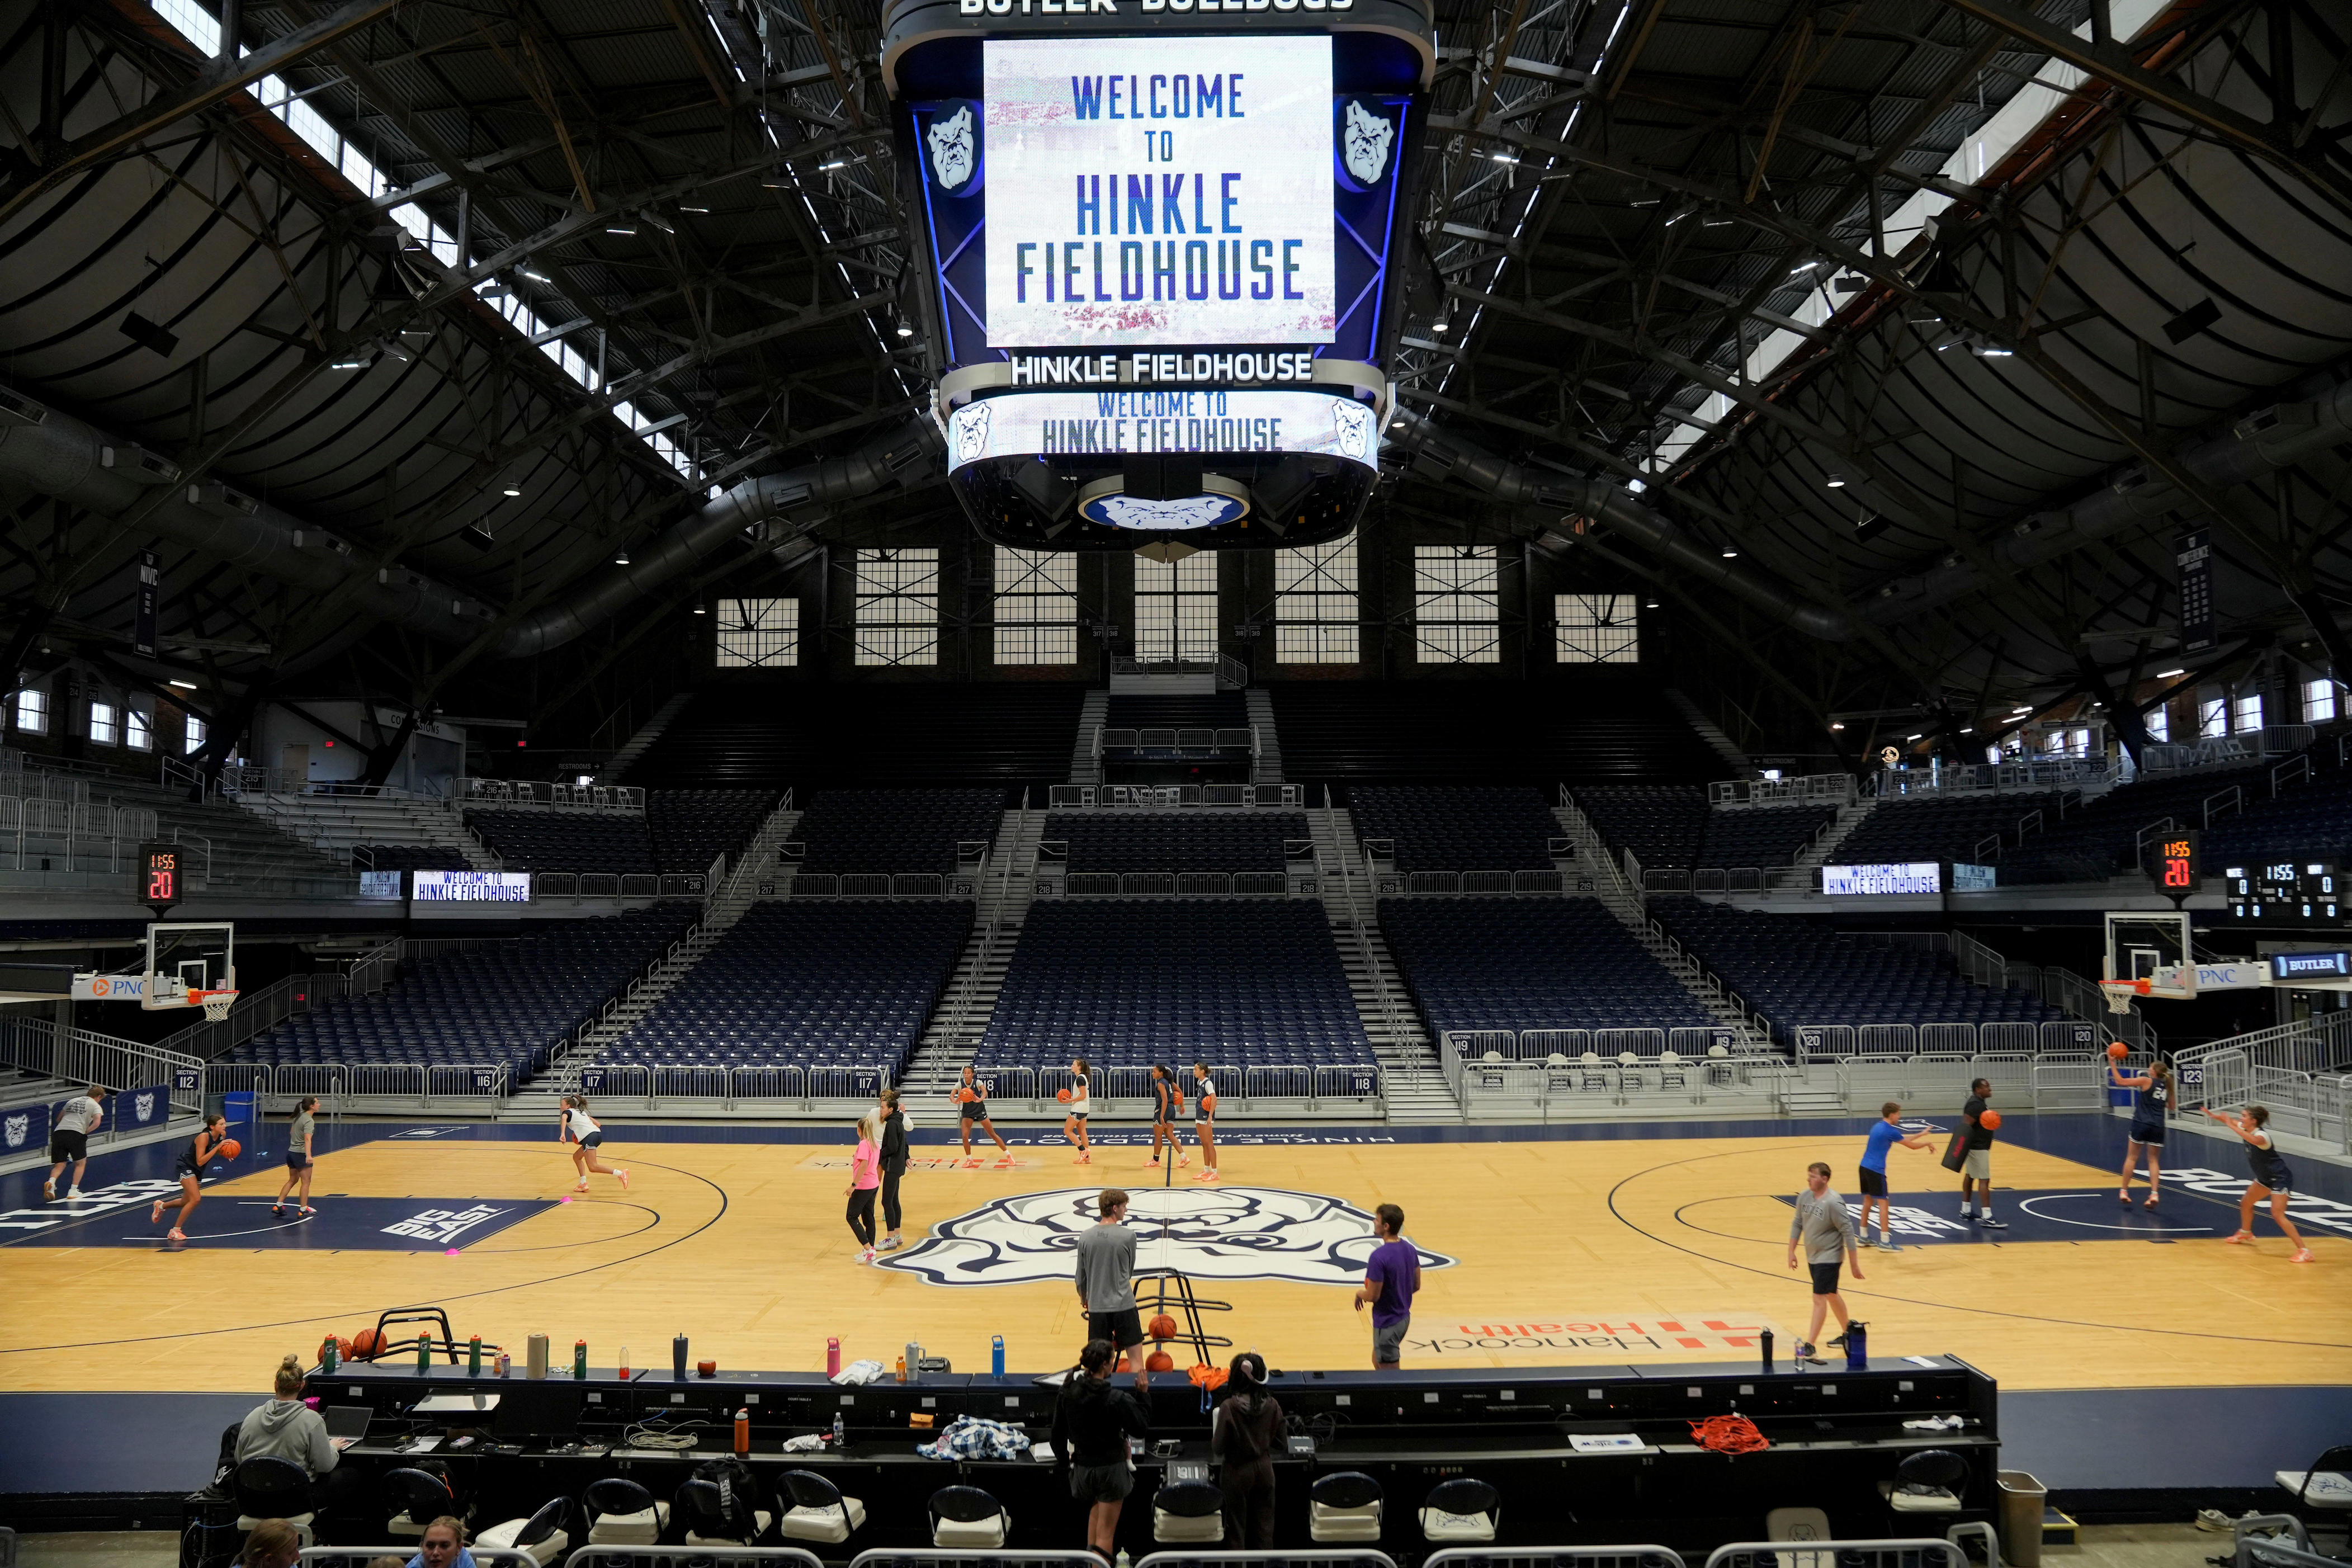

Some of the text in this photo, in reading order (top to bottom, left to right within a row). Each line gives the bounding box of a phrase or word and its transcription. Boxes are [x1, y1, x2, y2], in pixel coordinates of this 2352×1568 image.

[1072, 73, 1244, 120] WELCOME
[1145, 130, 1173, 162] TO
[1076, 173, 1243, 235] HINKLE
[1016, 239, 1303, 303] FIELDHOUSE
[1012, 353, 1312, 385] HINKLE FIELDHOUSE
[1098, 391, 1227, 417] WELCOME TO
[1043, 418, 1282, 454] HINKLE FIELDHOUSE
[140, 565, 157, 585] NIVC
[2165, 841, 2190, 857] 11:55
[152, 854, 174, 870] 11:55
[1851, 863, 1910, 877] WELCOME TO
[444, 871, 502, 885] WELCOME TO
[2165, 859, 2190, 886] 20
[150, 871, 172, 898] 20
[419, 884, 525, 901] HINKLE FIELDHOUSE
[1830, 878, 1864, 894] HINKLE
[1869, 876, 1934, 894] FIELDHOUSE
[2239, 879, 2247, 894] 0
[2322, 876, 2332, 893] 0
[2288, 958, 2335, 971] BUTLER
[2199, 969, 2238, 985] PNC
[1716, 1037, 1730, 1047] 119
[1805, 1035, 1820, 1046] 20
[2075, 1031, 2091, 1041] 120
[1455, 1040, 1468, 1051] 119
[180, 1076, 193, 1088] 112
[478, 1076, 490, 1087] 116
[587, 1076, 600, 1087] 117
[859, 1078, 872, 1089] 117
[1356, 1078, 1370, 1090] 118
[2183, 1070, 2203, 1083] 123
[380, 1208, 456, 1236] BIG
[408, 1203, 498, 1240] EAST
[1459, 1321, 1646, 1337] Health
[1406, 1335, 1663, 1353] Hancock
